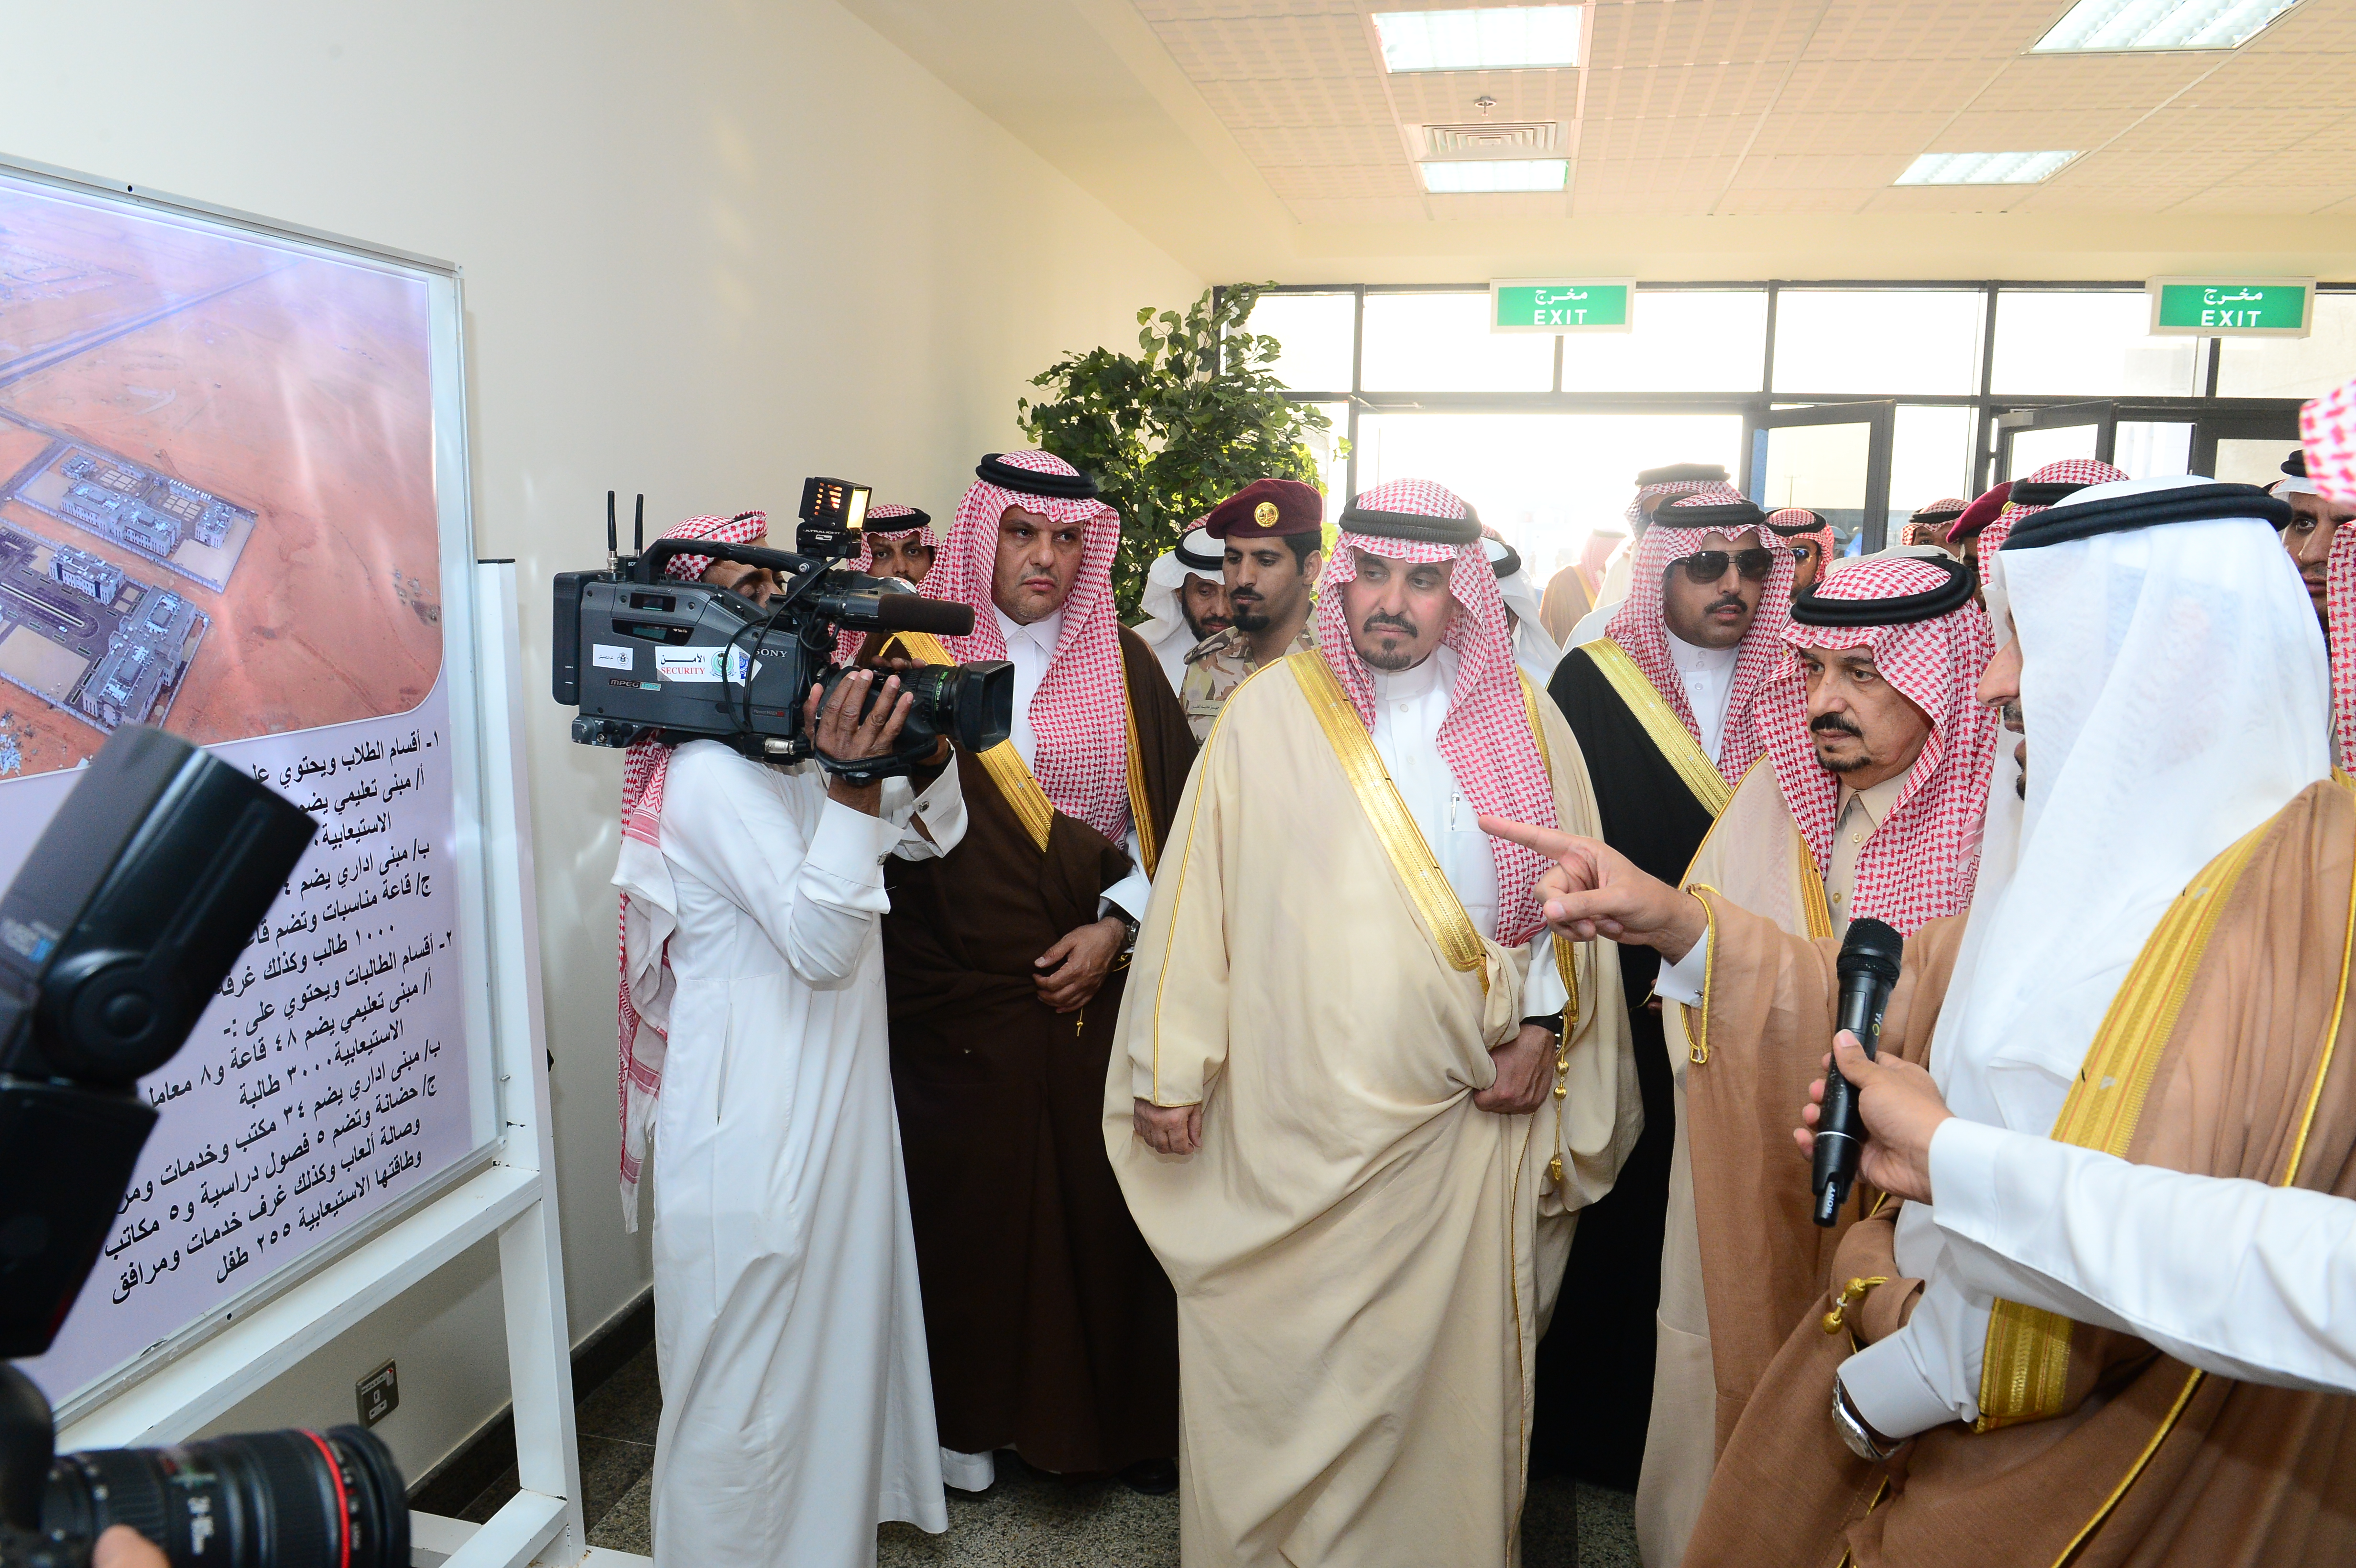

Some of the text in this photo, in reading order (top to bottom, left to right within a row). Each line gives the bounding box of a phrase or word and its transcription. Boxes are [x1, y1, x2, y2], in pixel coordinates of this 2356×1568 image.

[1535, 288, 1588, 305] مخرج
[2203, 287, 2263, 305] مخرج
[1534, 309, 1587, 325] EXIT
[2201, 310, 2261, 327] EXIT
[611, 679, 639, 687] MPEG
[341, 740, 384, 772] الطلاب
[389, 728, 422, 767] أقسام
[251, 762, 270, 784] عل
[279, 755, 337, 790] ويحتوي
[382, 773, 412, 804] مبنى
[334, 778, 378, 816] تعليمي
[379, 845, 408, 876] مبنى
[300, 867, 331, 903] يضم
[382, 872, 412, 901] قاعة
[322, 889, 378, 922] مناسبات
[275, 910, 317, 949] وتضم
[263, 950, 308, 980] وكذلك
[312, 932, 348, 967] طالب
[402, 932, 434, 974] أقسام
[344, 950, 397, 987] الطالبات
[284, 979, 340, 1021] ويحتوي
[340, 991, 385, 1034] تعليمي
[389, 981, 419, 1014] مبنى
[245, 1000, 275, 1037] على
[304, 1015, 335, 1051] يضم
[230, 1036, 267, 1070] قاعة
[391, 1050, 420, 1083] مبنى
[239, 1073, 281, 1110] طالبة
[314, 1086, 344, 1122] يضم
[375, 1086, 419, 1114] حضانة
[235, 1118, 277, 1153] مكتب
[316, 1130, 325, 1144] ٥
[332, 1108, 371, 1149] وتضم
[160, 1143, 229, 1186] وخدمات
[265, 1132, 310, 1179] فصول
[374, 1150, 422, 1189] وطاقتها
[200, 1165, 260, 1209] دراسية
[298, 1174, 371, 1232] الاستيعابية
[1826, 1187, 1836, 1214] SONY
[112, 1118, 421, 1305] وصالة ألعاب وكذلك غرف خدمات ومرافق
[104, 1217, 160, 1261] مكاتب
[216, 1245, 249, 1284] طفل
